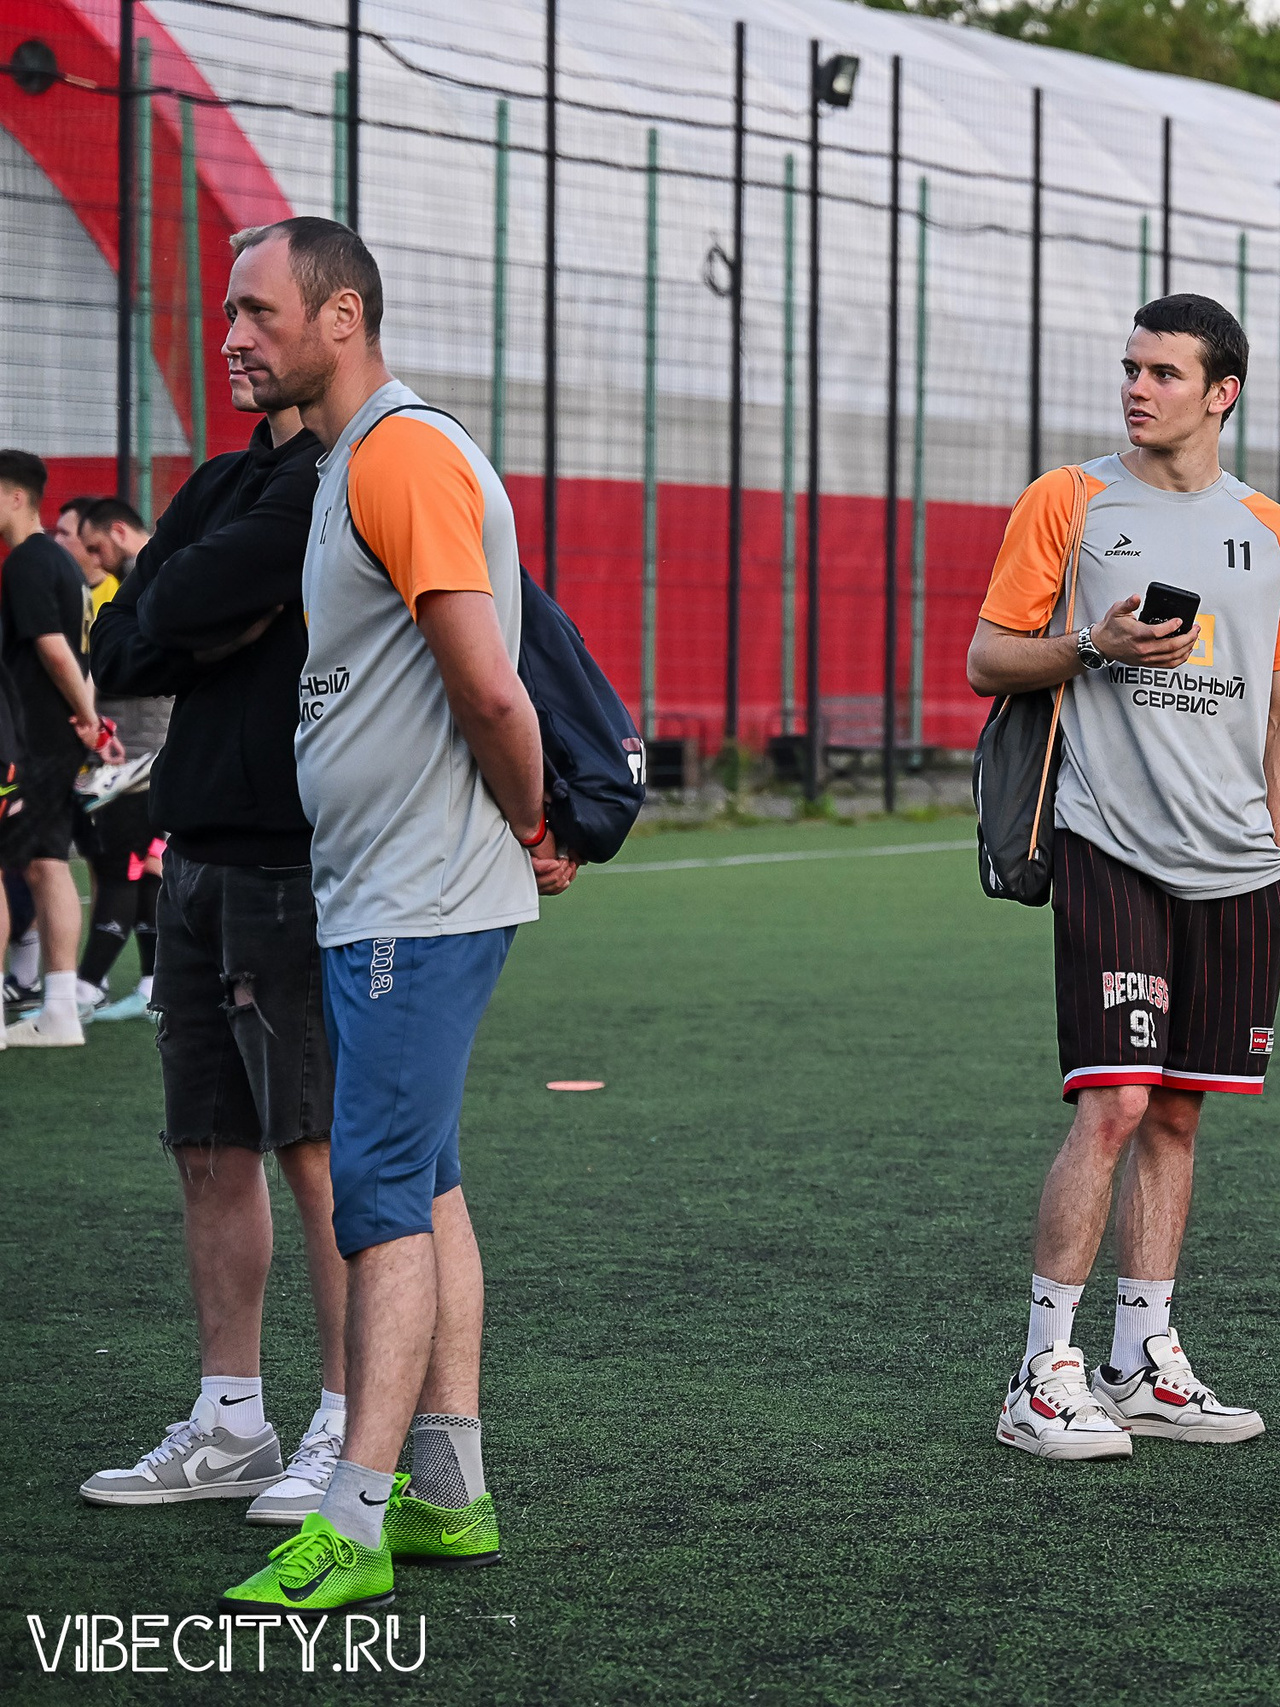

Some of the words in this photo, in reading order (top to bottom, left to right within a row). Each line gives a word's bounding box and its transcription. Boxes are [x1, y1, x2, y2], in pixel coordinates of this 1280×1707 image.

[1223, 539, 1252, 571] 11
[299, 666, 350, 697] НЫЙ
[1108, 666, 1246, 700] МЕБЕЛЬНЫЙ
[299, 701, 324, 722] ИС
[1132, 689, 1219, 716] СЕРВИС
[1102, 971, 1170, 1014] RECKLESS
[1032, 1291, 1056, 1309] LA
[1118, 1294, 1149, 1308] ILA
